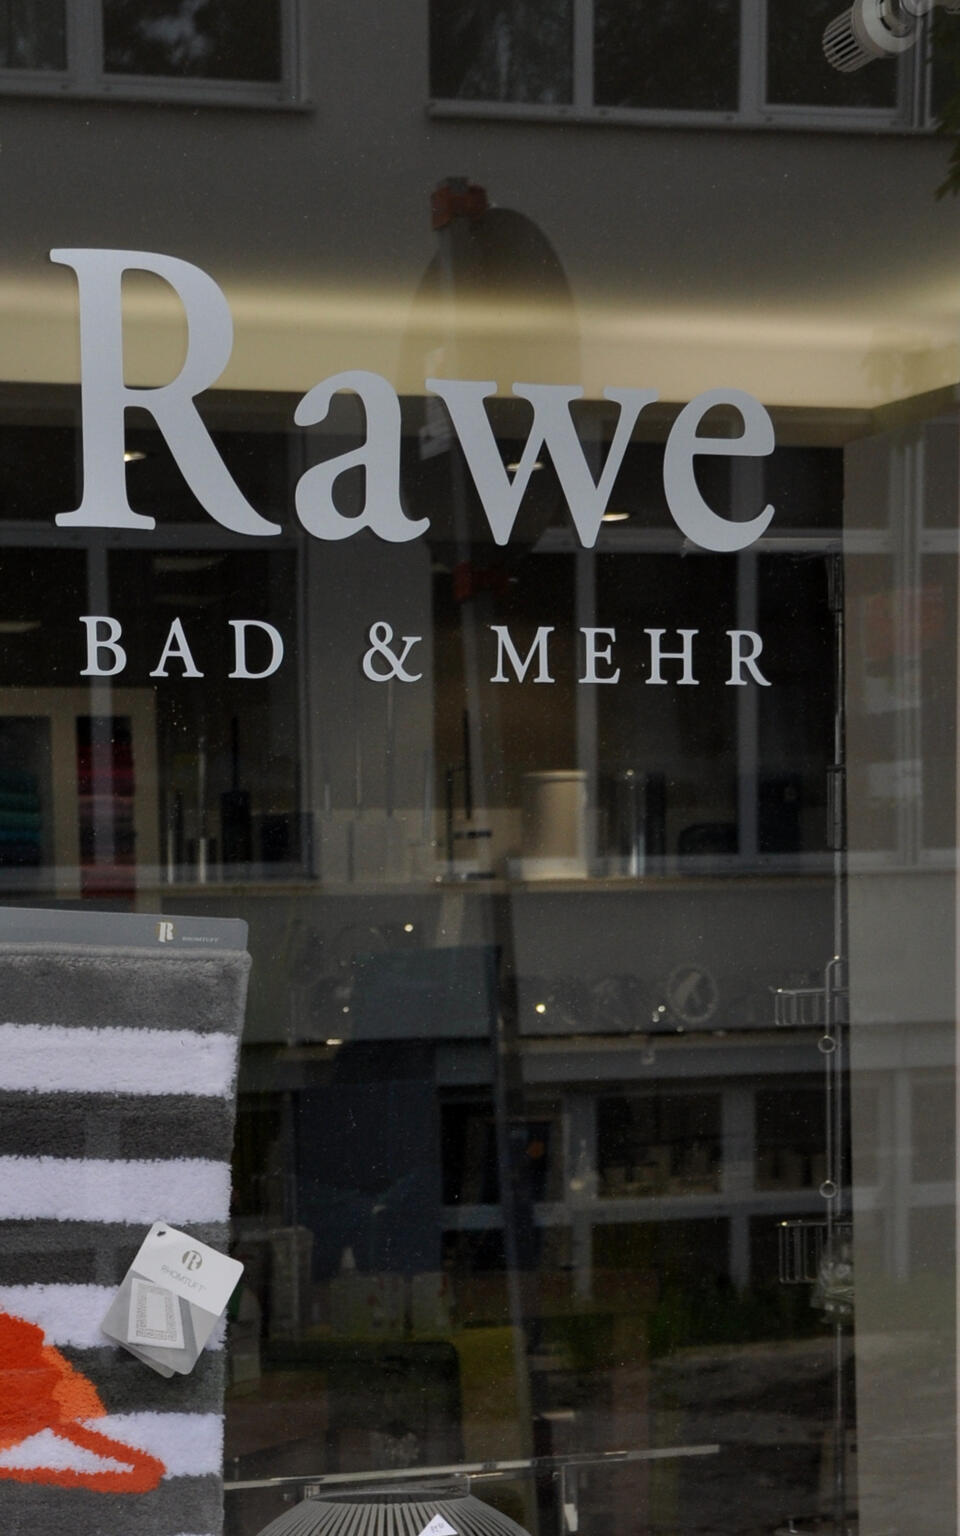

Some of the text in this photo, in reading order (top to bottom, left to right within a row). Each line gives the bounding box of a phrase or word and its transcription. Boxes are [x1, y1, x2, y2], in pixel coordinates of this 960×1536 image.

[49, 247, 776, 553] Rawe
[78, 615, 773, 688] BAD & MEHR
